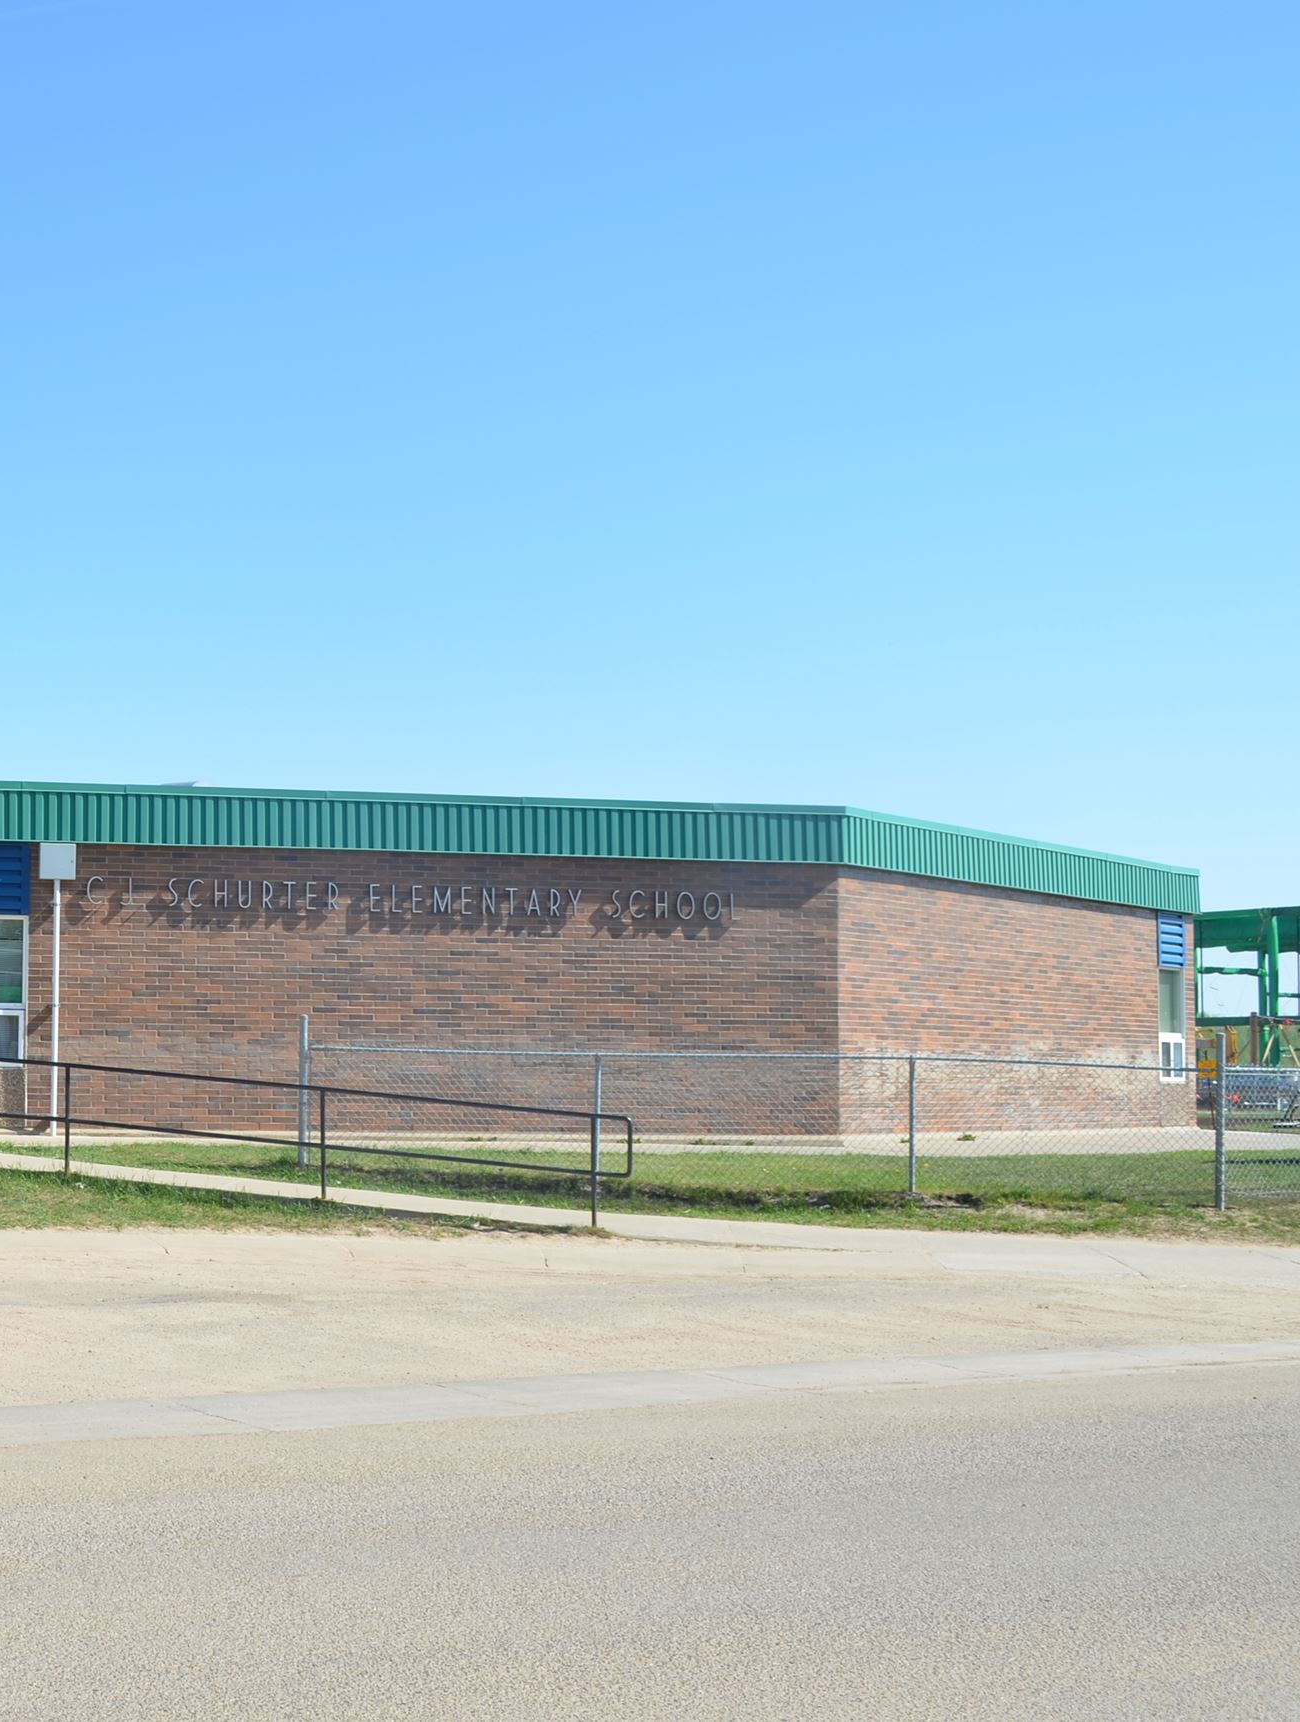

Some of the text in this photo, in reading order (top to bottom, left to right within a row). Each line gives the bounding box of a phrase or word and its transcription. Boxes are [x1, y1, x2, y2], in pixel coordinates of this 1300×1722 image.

[86, 875, 741, 921] C J SCHURTER ELEMENTARY SCHOOL
